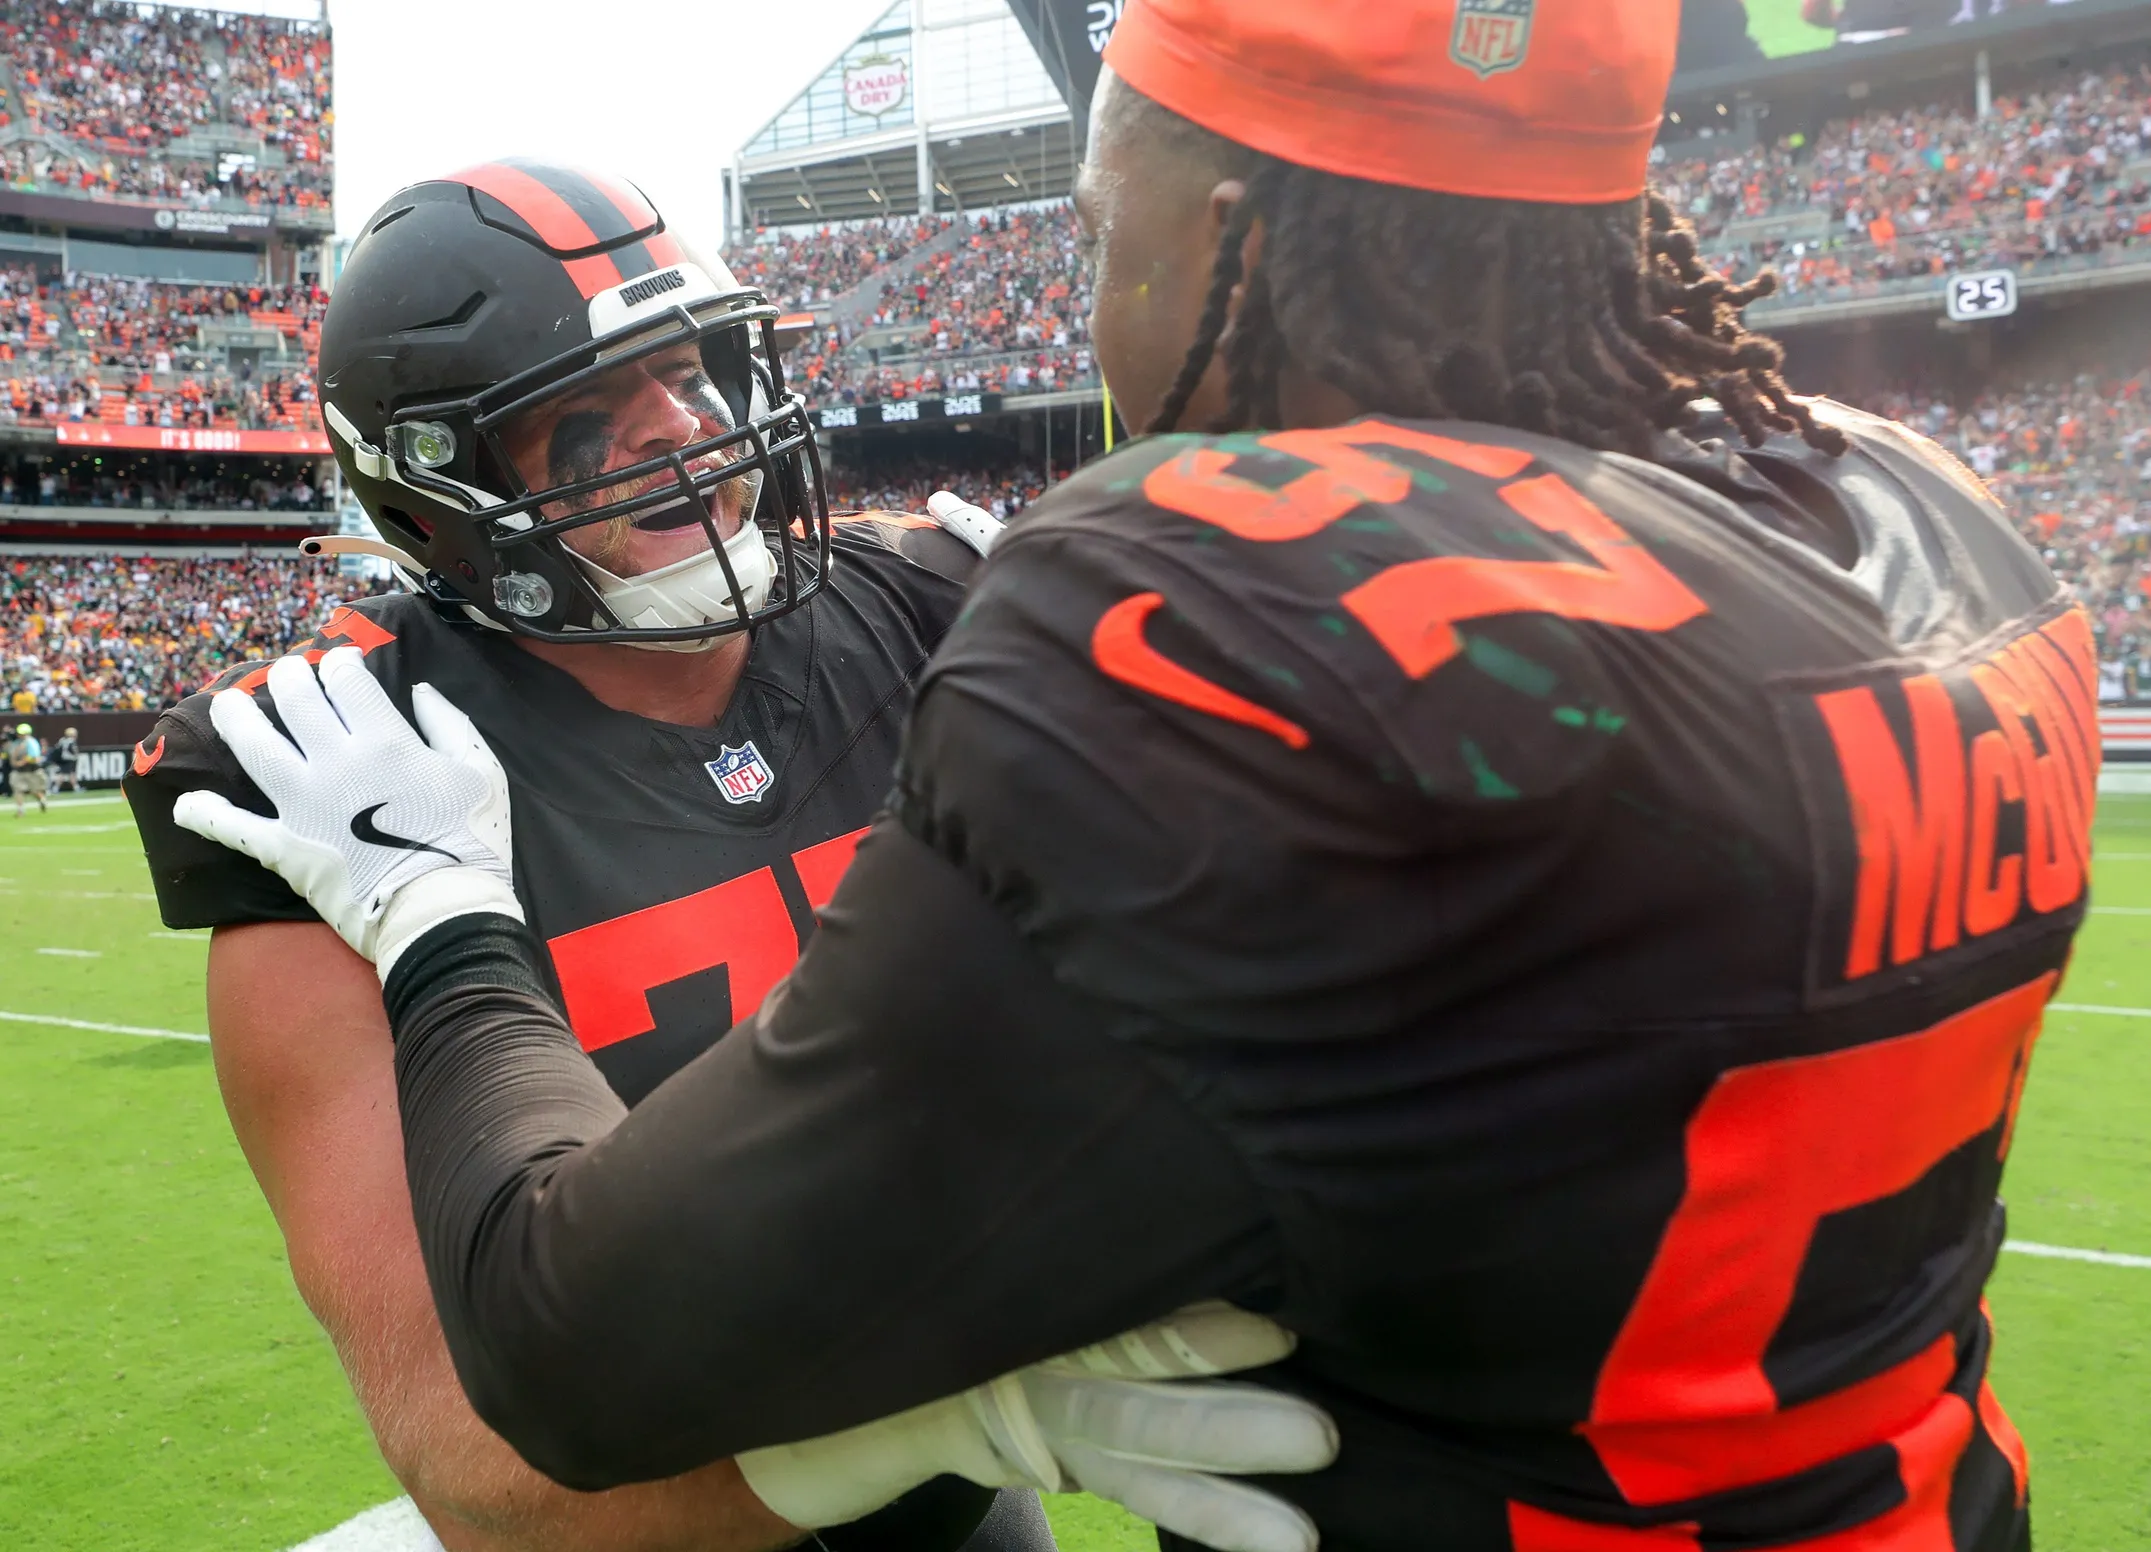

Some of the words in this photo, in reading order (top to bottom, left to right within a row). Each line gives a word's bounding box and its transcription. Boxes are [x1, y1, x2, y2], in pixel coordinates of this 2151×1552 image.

[1460, 17, 1518, 62] NFL
[844, 72, 907, 94] CANADA
[861, 90, 890, 106] DRY
[619, 269, 686, 307] BROWNS
[1958, 277, 2006, 313] 25
[160, 429, 190, 449] IT'S
[1143, 420, 1711, 680] 57
[724, 765, 766, 796] NFL
[546, 824, 872, 1054] 7
